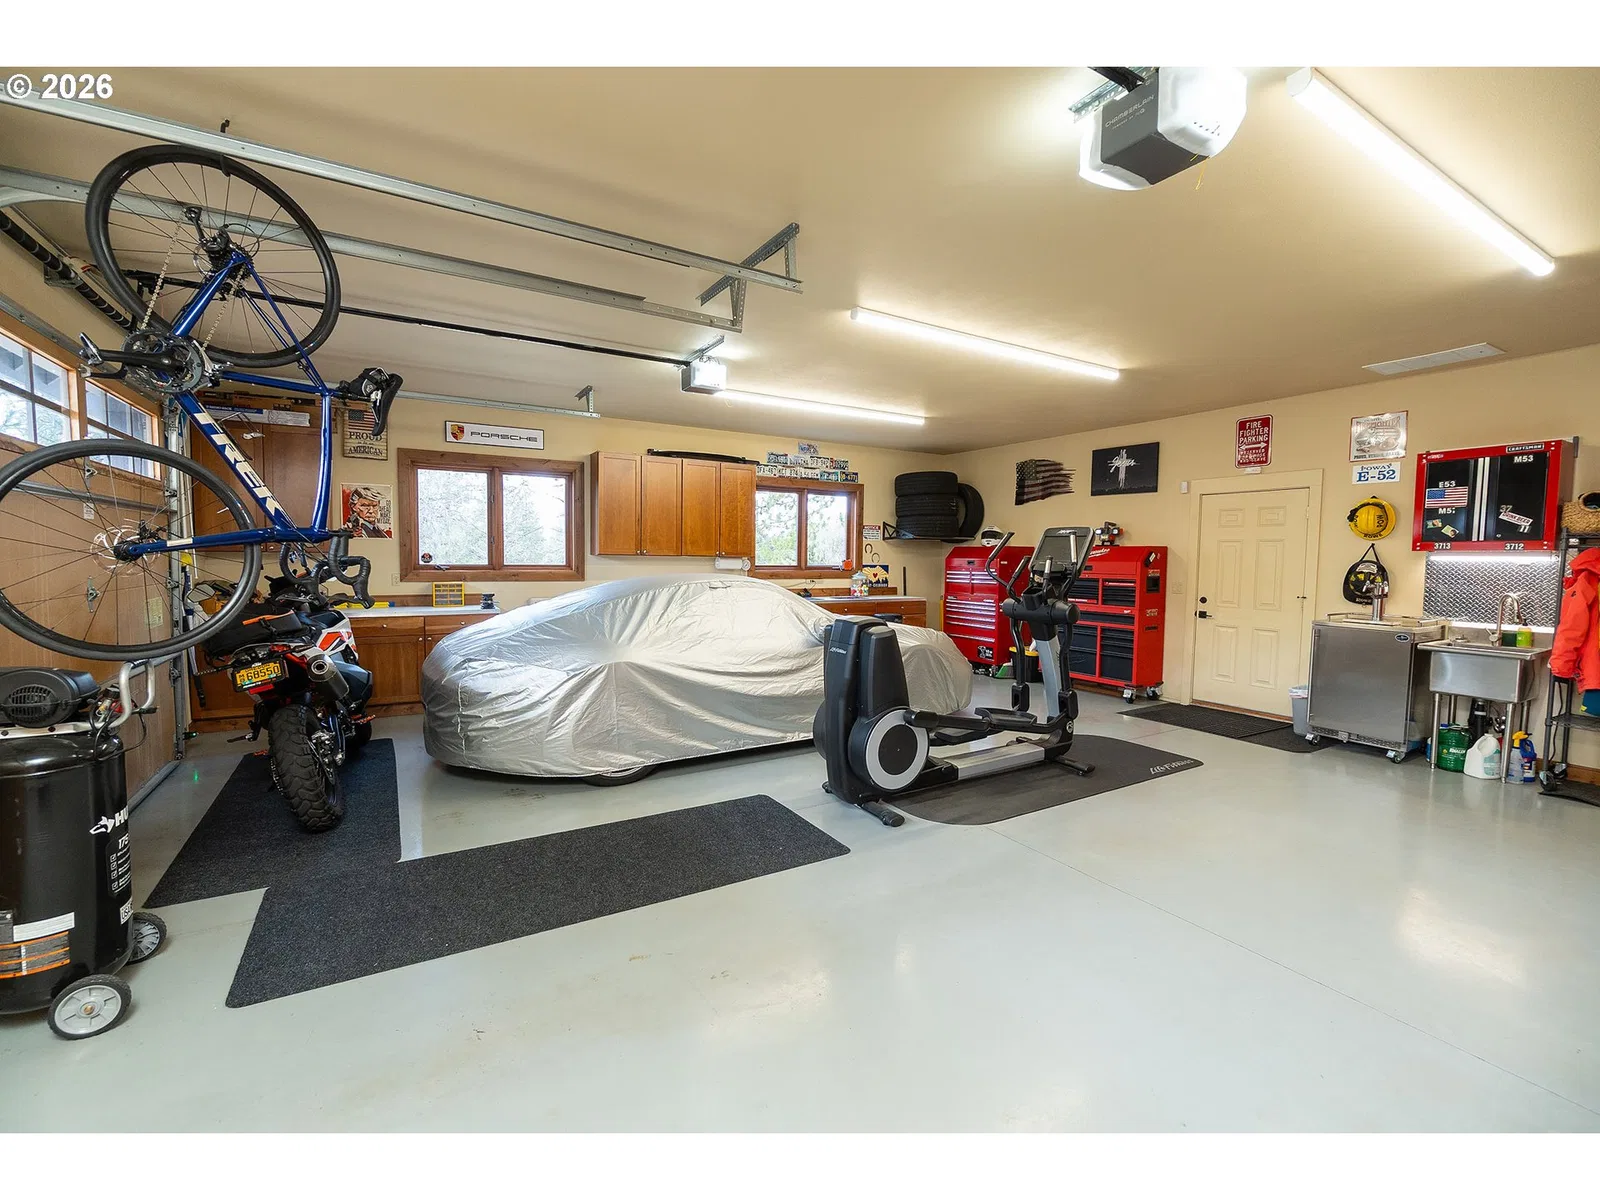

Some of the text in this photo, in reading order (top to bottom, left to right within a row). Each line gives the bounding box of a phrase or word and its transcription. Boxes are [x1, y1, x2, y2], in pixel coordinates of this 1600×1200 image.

[1105, 95, 1155, 128] CHAMBERLAIN
[1246, 421, 1262, 430] FIRE
[470, 431, 538, 442] PORSCHE
[1240, 427, 1269, 438] FIGHTER
[1240, 434, 1269, 444] PARKING
[348, 445, 383, 456] AMERICAN
[1508, 444, 1543, 452] CRAFTSMAN
[1513, 455, 1534, 463] M53
[194, 402, 297, 528] TREK
[1360, 463, 1393, 471] POWAY
[1357, 470, 1396, 482] E-52
[1516, 516, 1531, 524] BEER
[1434, 542, 1451, 550] 3713
[246, 665, 280, 681] 68550
